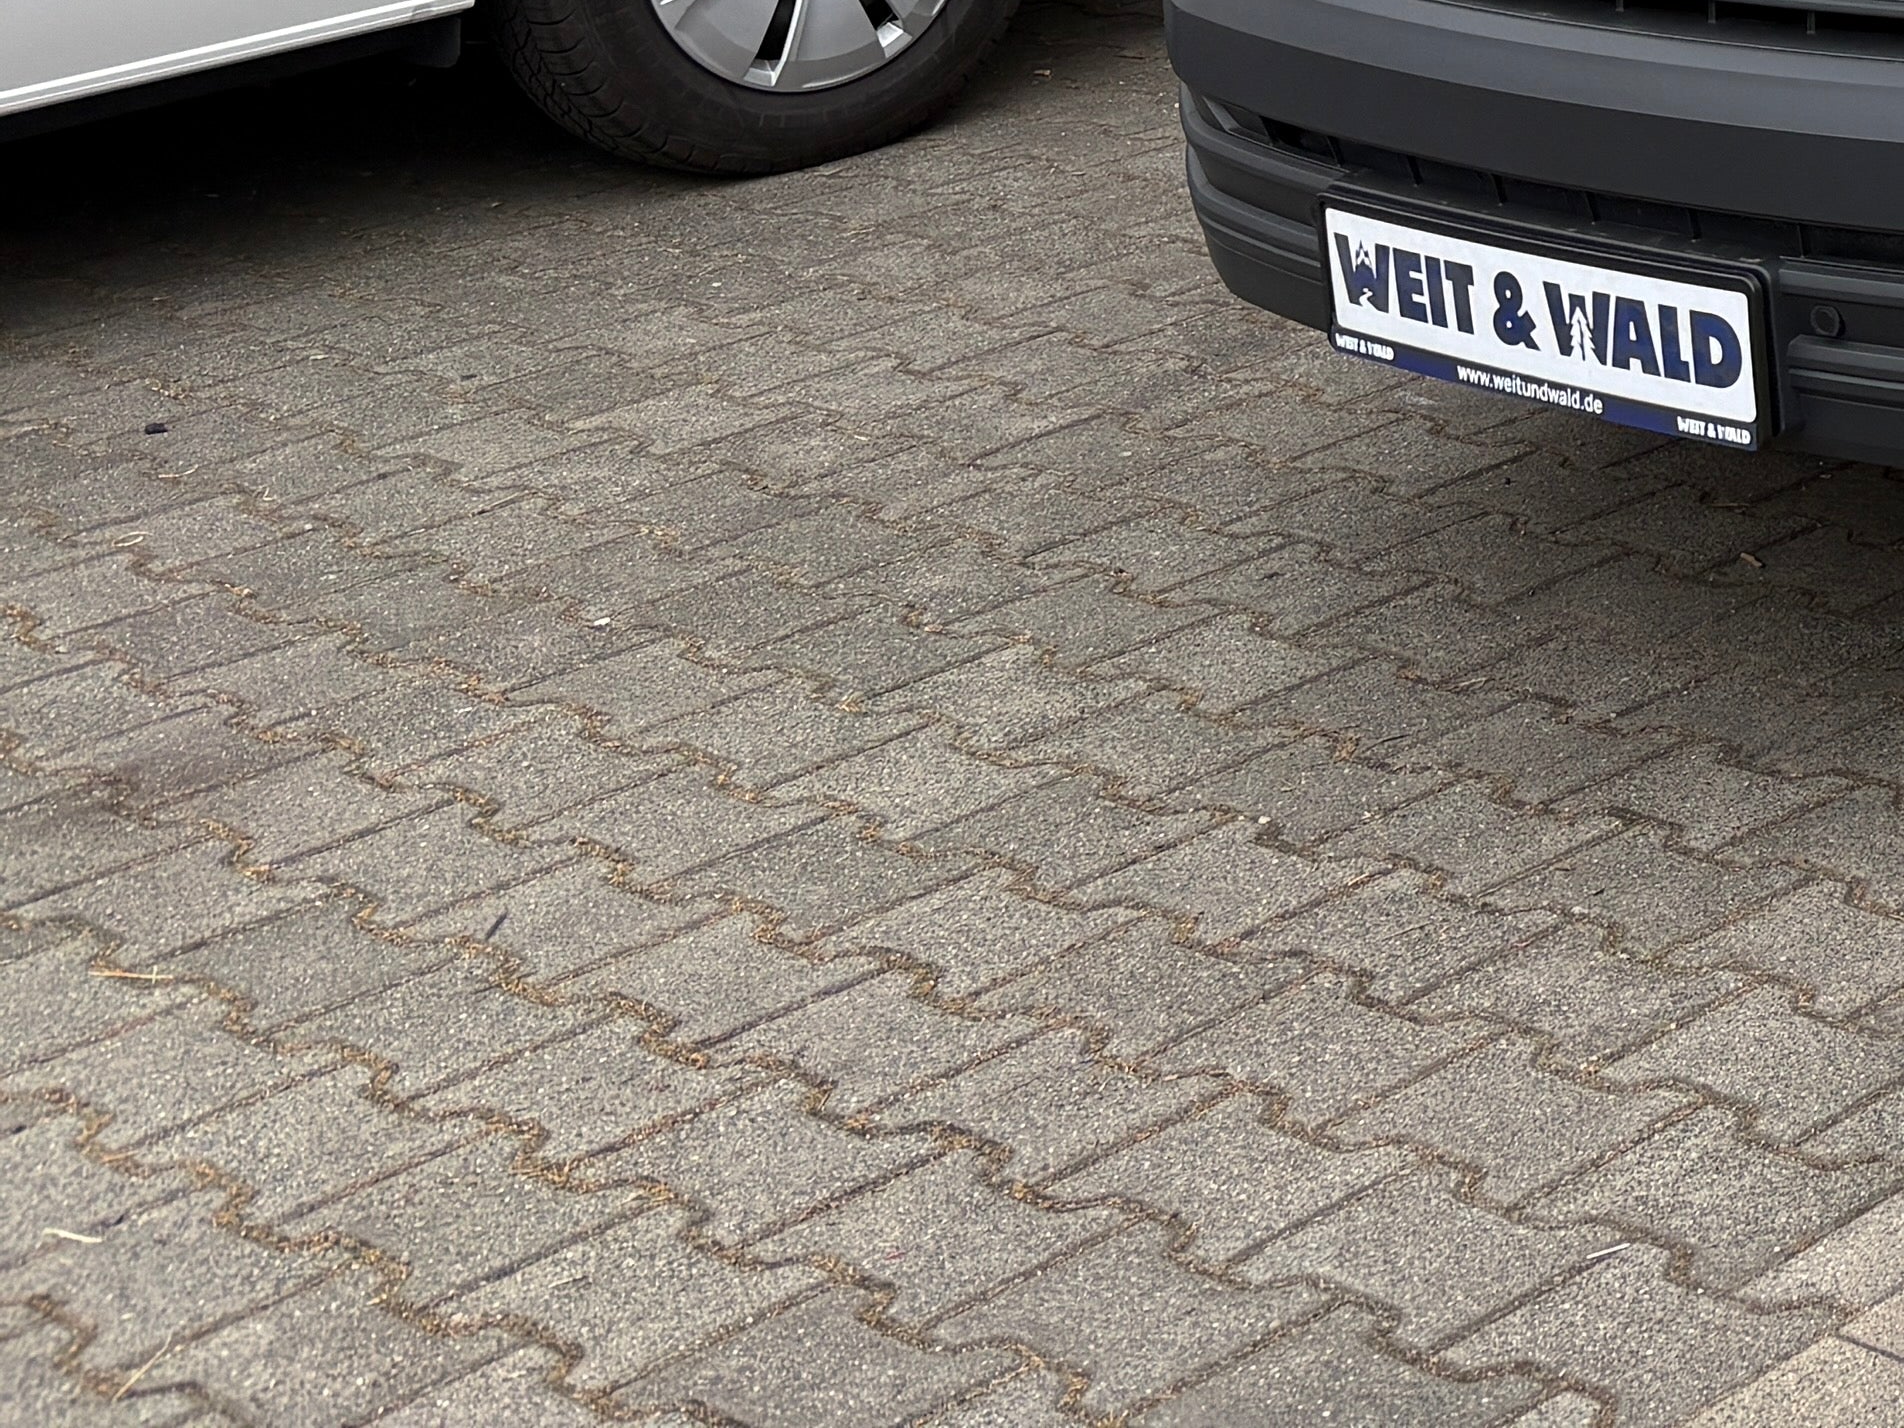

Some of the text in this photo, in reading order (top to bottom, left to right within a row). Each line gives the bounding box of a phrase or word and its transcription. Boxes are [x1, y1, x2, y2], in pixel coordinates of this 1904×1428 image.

[1334, 231, 1743, 389] WEIT & WALD
[1456, 365, 1604, 414] www.weitundwald.de
[1676, 415, 1706, 436] WEIT
